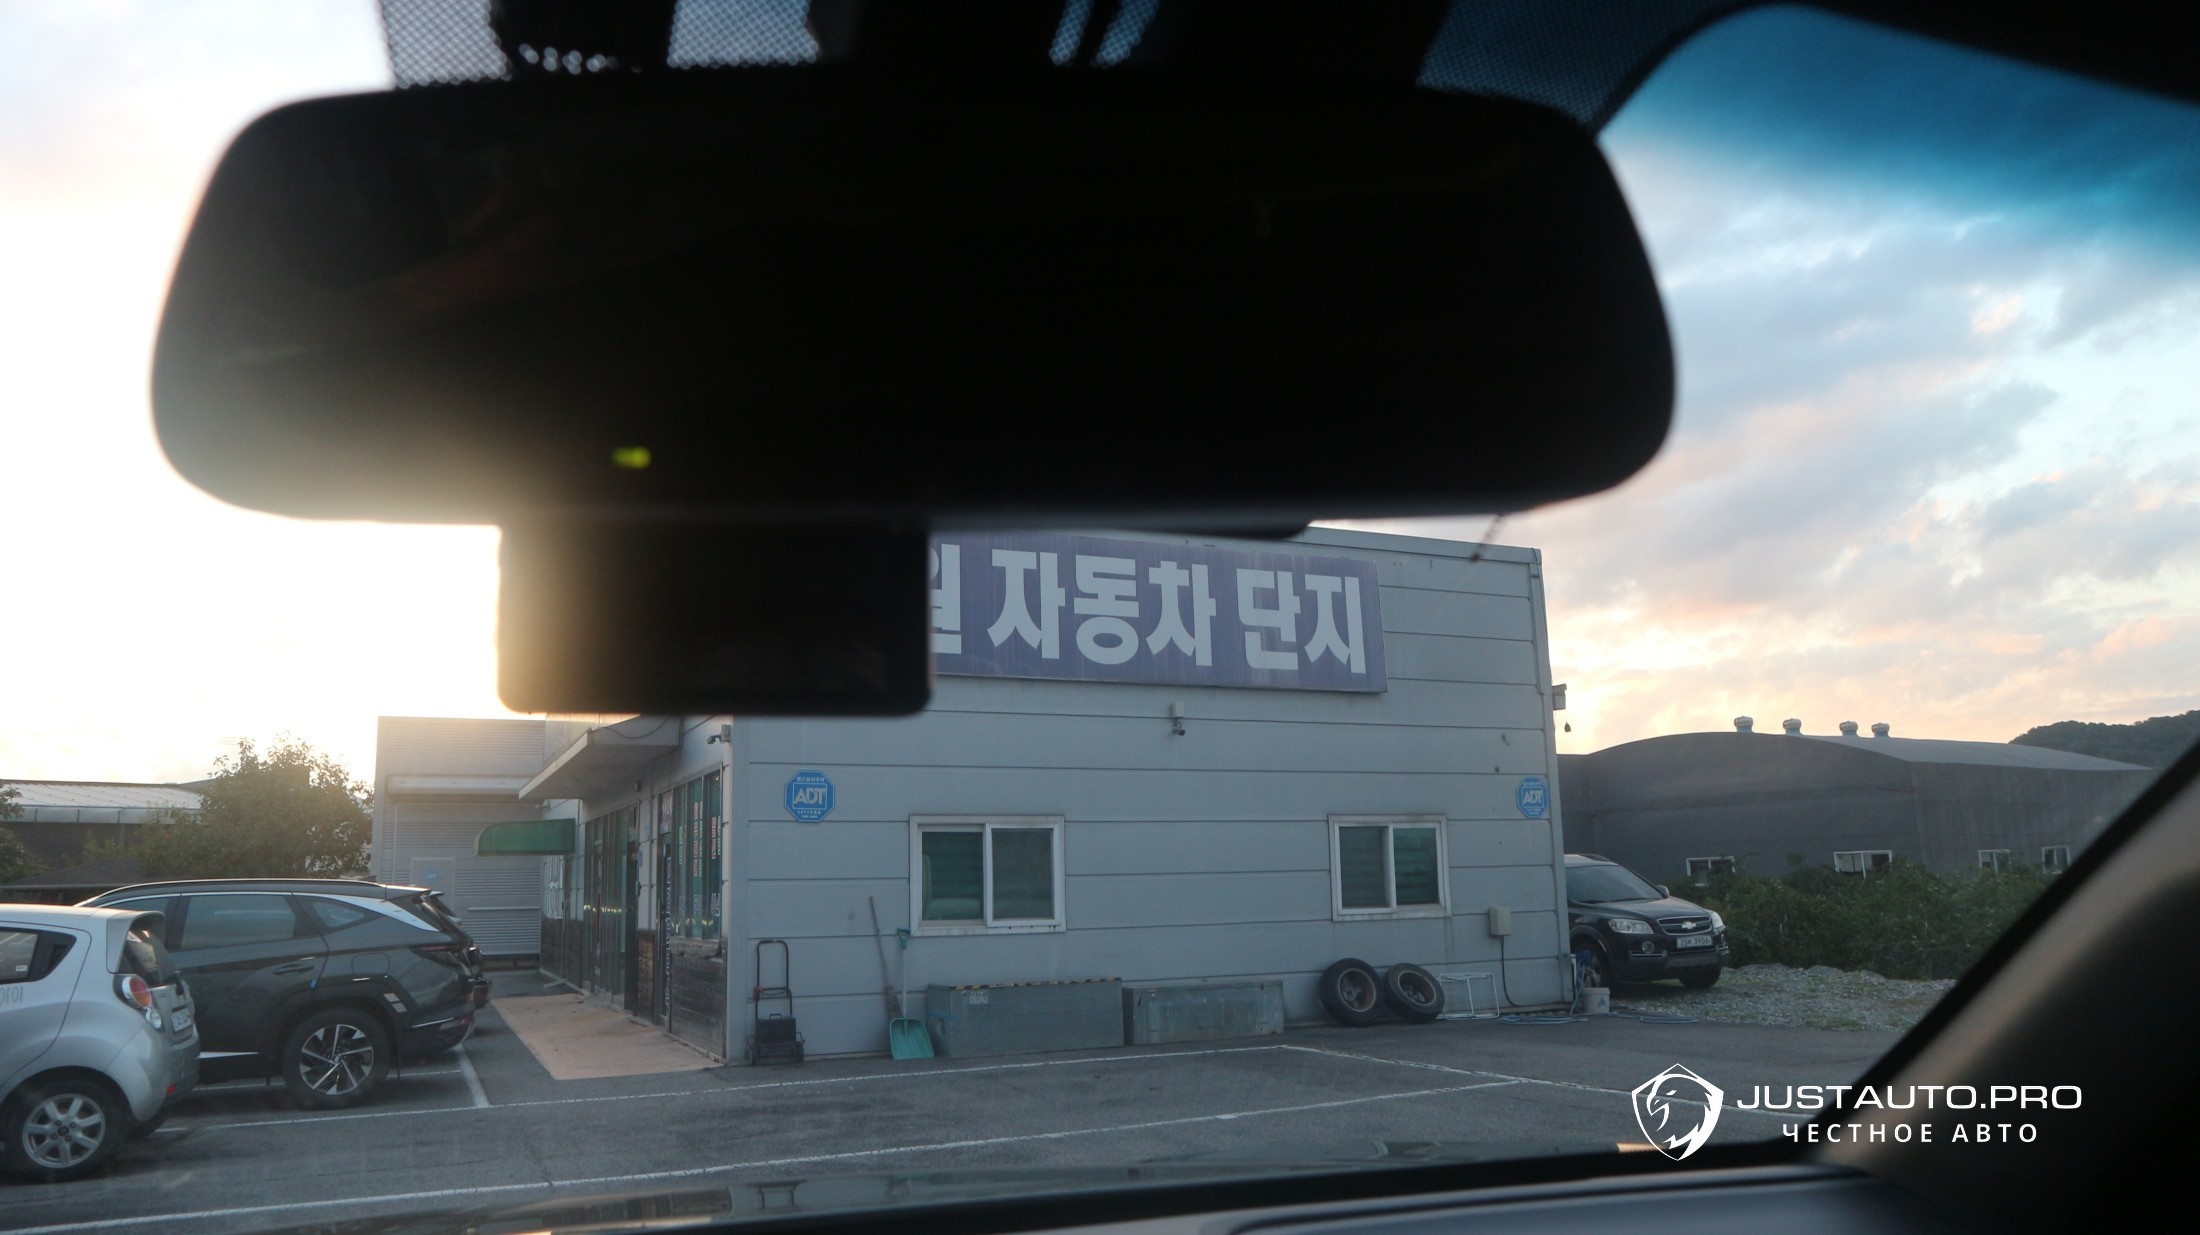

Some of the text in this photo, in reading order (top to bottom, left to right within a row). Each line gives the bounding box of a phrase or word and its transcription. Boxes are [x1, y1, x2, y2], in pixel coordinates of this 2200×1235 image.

[986, 549, 1216, 666] 자동차
[1237, 568, 1366, 673] 단지
[793, 787, 827, 804] ADT
[1523, 790, 1543, 804] ADT
